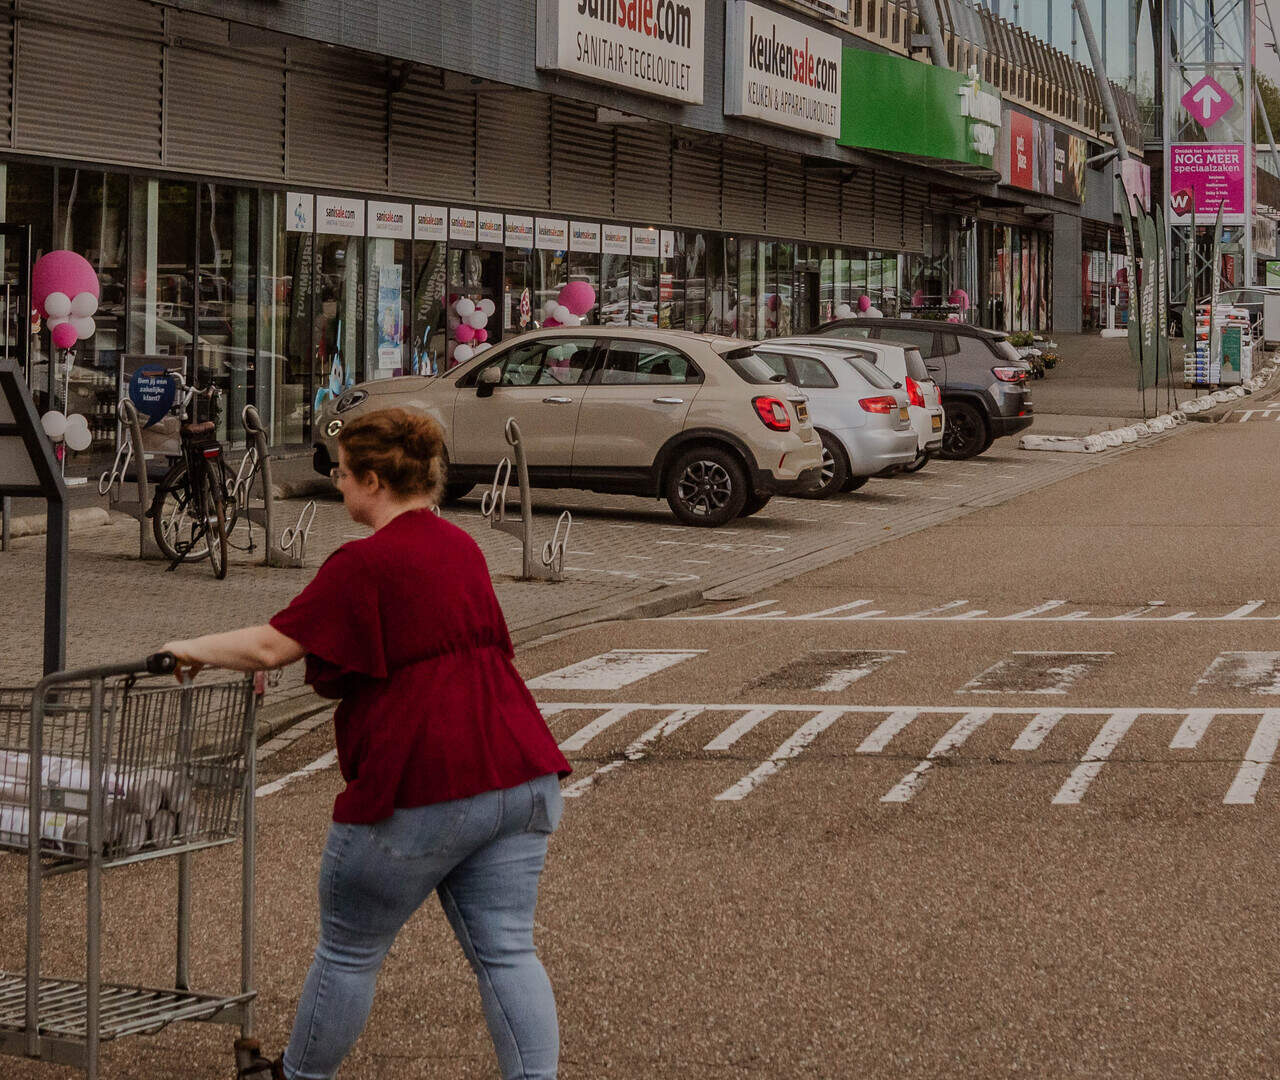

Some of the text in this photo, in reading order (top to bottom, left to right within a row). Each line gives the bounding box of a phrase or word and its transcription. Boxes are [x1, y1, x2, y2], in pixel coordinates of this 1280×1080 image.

[576, 30, 691, 93] SANITAIR-TEGELOUTLET
[749, 15, 838, 95] keukensale.com
[747, 80, 838, 127] KEUKEN & APPARATUUROUTLET
[1174, 164, 1240, 174] speciaalzaken
[1175, 154, 1240, 164] NOG MEER
